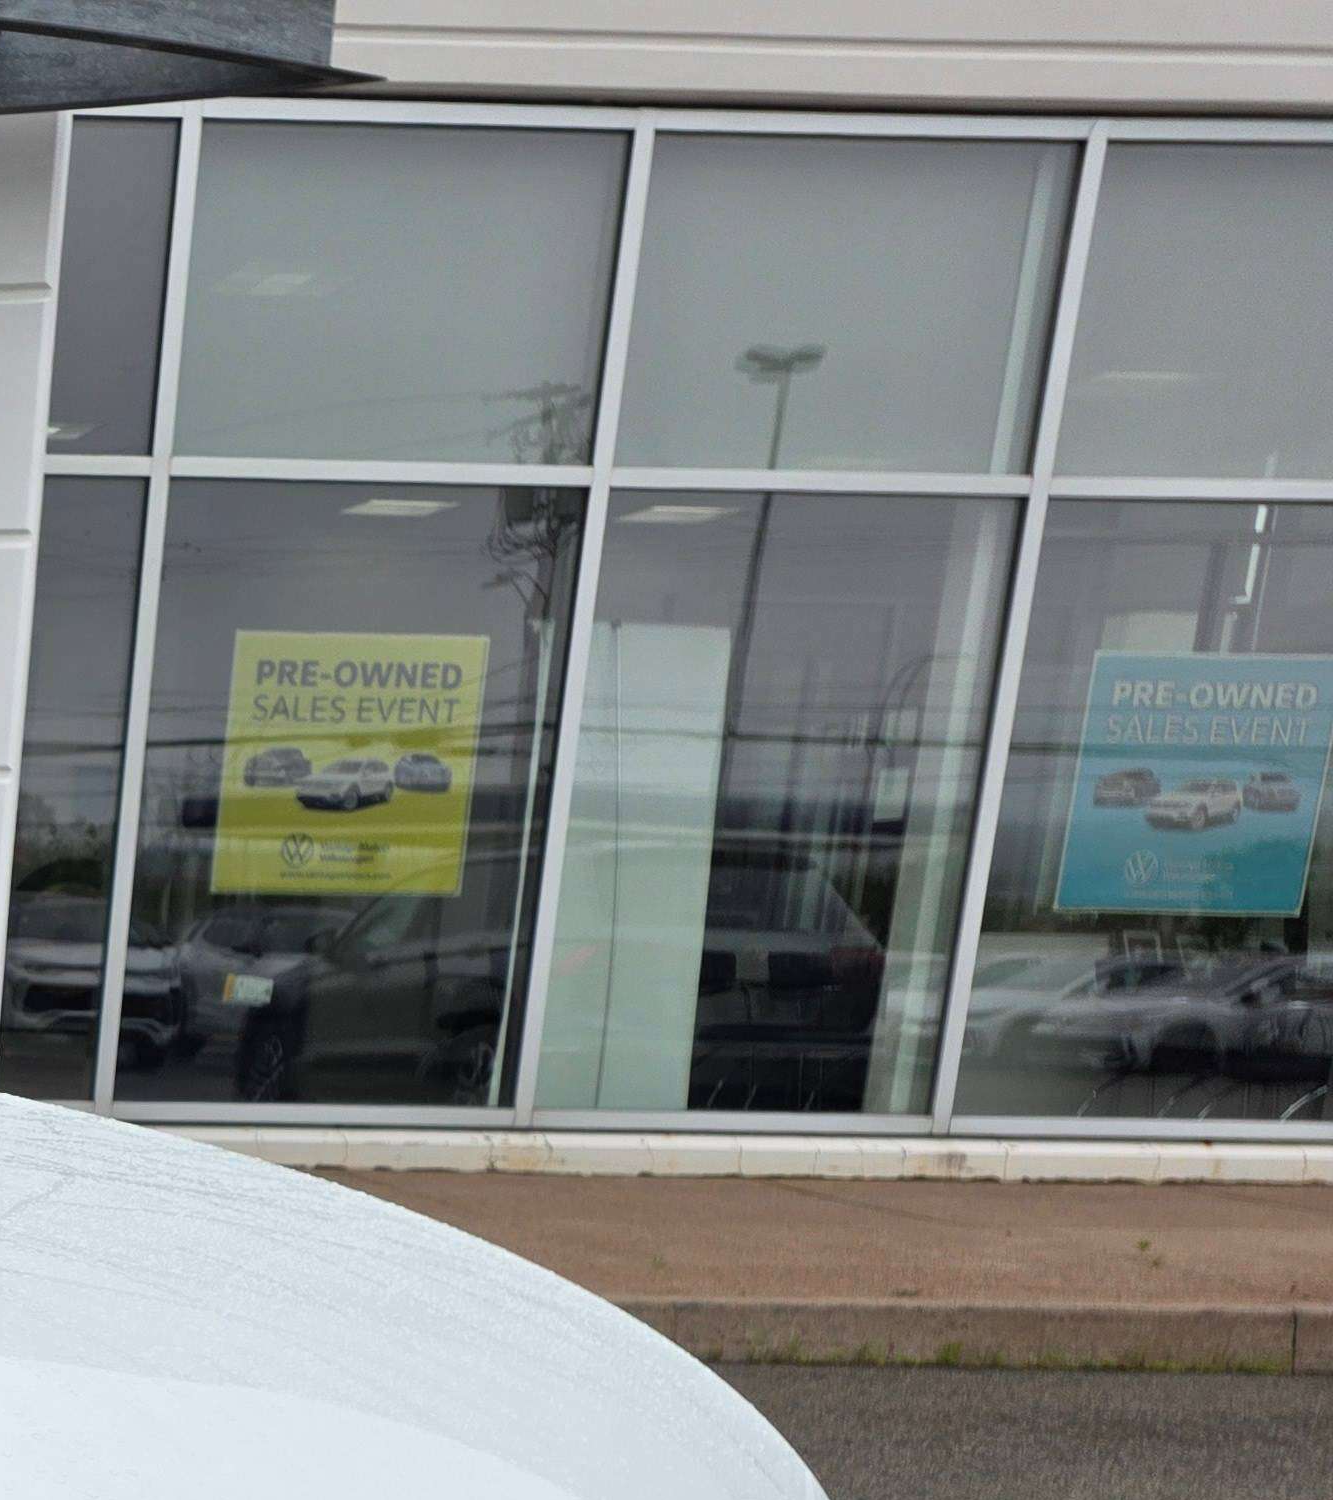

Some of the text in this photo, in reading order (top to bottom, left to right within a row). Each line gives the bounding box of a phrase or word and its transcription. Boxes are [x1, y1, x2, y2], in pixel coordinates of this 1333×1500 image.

[255, 660, 464, 690] PRE-OWNED
[252, 694, 462, 725] SALES EVENT
[1112, 678, 1319, 711] PRE-OWNED
[1106, 714, 1312, 747] SALES EVENT
